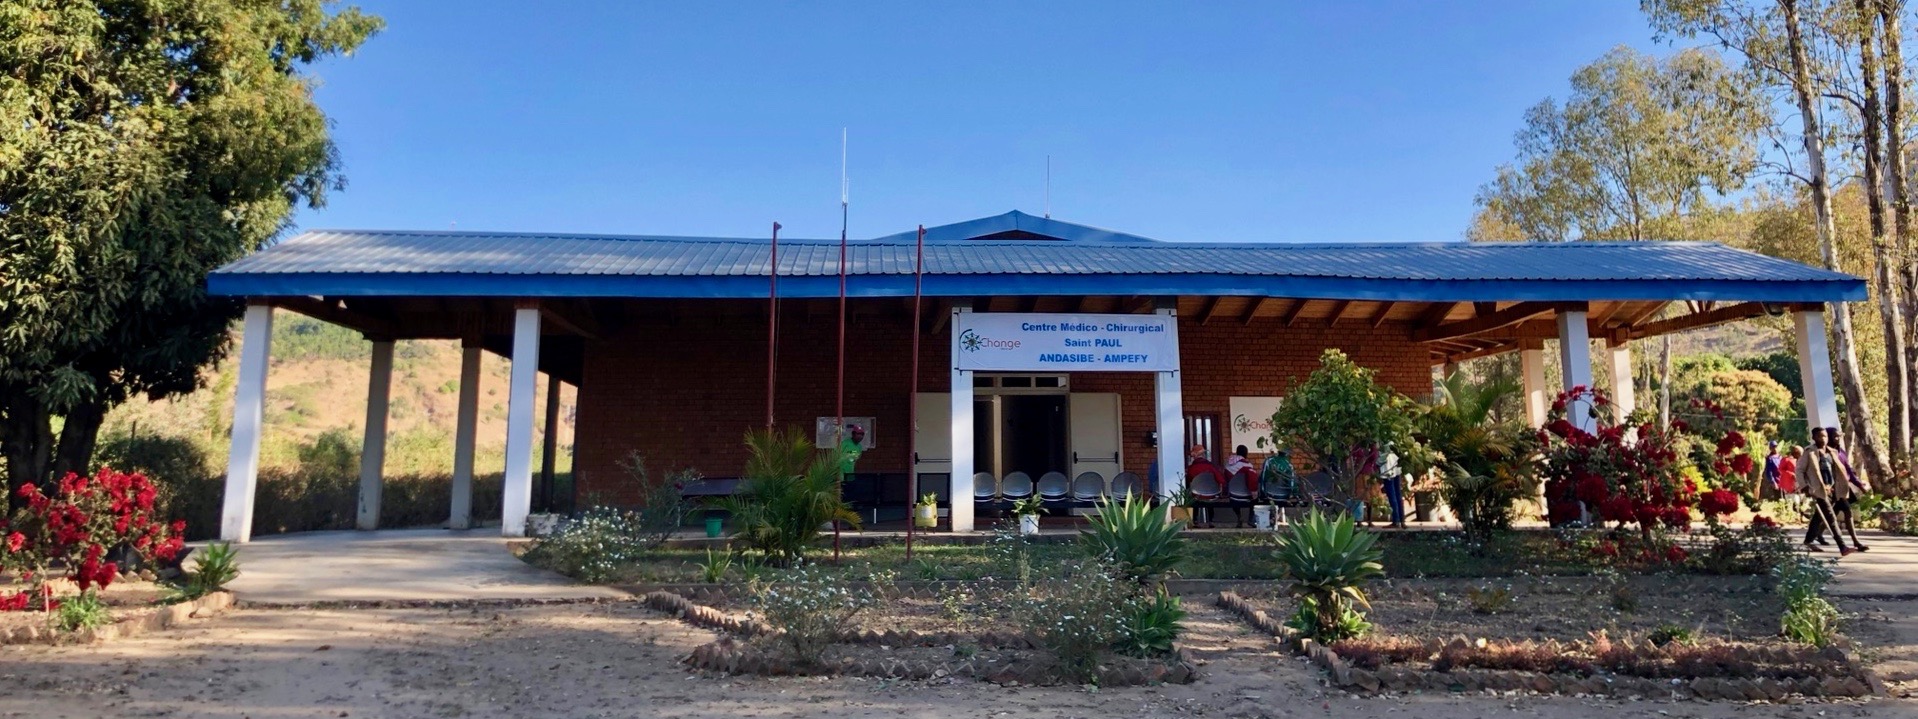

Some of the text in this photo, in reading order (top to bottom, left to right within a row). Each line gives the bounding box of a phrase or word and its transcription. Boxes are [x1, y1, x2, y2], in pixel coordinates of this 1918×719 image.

[1021, 322, 1057, 332] Centre
[1060, 322, 1098, 332] Médico
[1106, 323, 1164, 334] Chirurgical
[1064, 338, 1122, 348] Saint PAUL
[1039, 353, 1095, 363] ANDASIBE
[1104, 354, 1148, 363] AMPEFY
